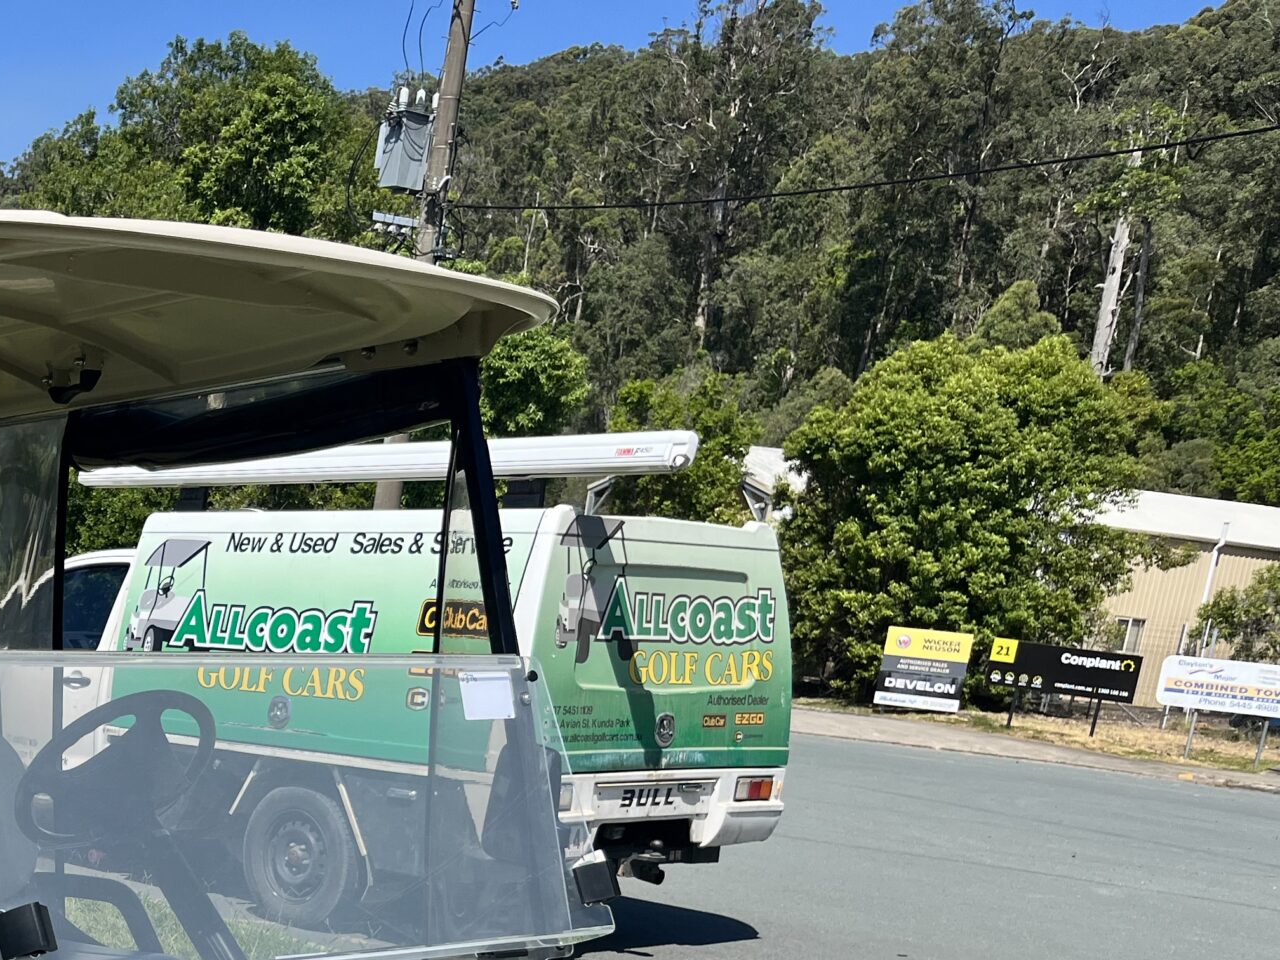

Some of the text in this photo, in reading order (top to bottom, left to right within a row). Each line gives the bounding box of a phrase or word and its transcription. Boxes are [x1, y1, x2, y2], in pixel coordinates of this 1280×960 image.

[226, 532, 267, 553] New
[270, 533, 284, 553] &
[289, 532, 339, 554] Used
[350, 532, 404, 555] Sales
[408, 532, 425, 554] &
[995, 645, 1011, 656] 21
[629, 649, 774, 687] GOLF CARS
[1060, 652, 1121, 671] Conplant
[197, 665, 366, 702] GOLF CARS
[884, 676, 956, 694] DEVELON
[1174, 680, 1248, 694] COMBINED
[707, 694, 770, 706] Authorised Dealer
[1198, 697, 1226, 707] Phone
[591, 718, 614, 729] Kunda
[615, 718, 631, 729] Park
[735, 713, 764, 725] EZGO
